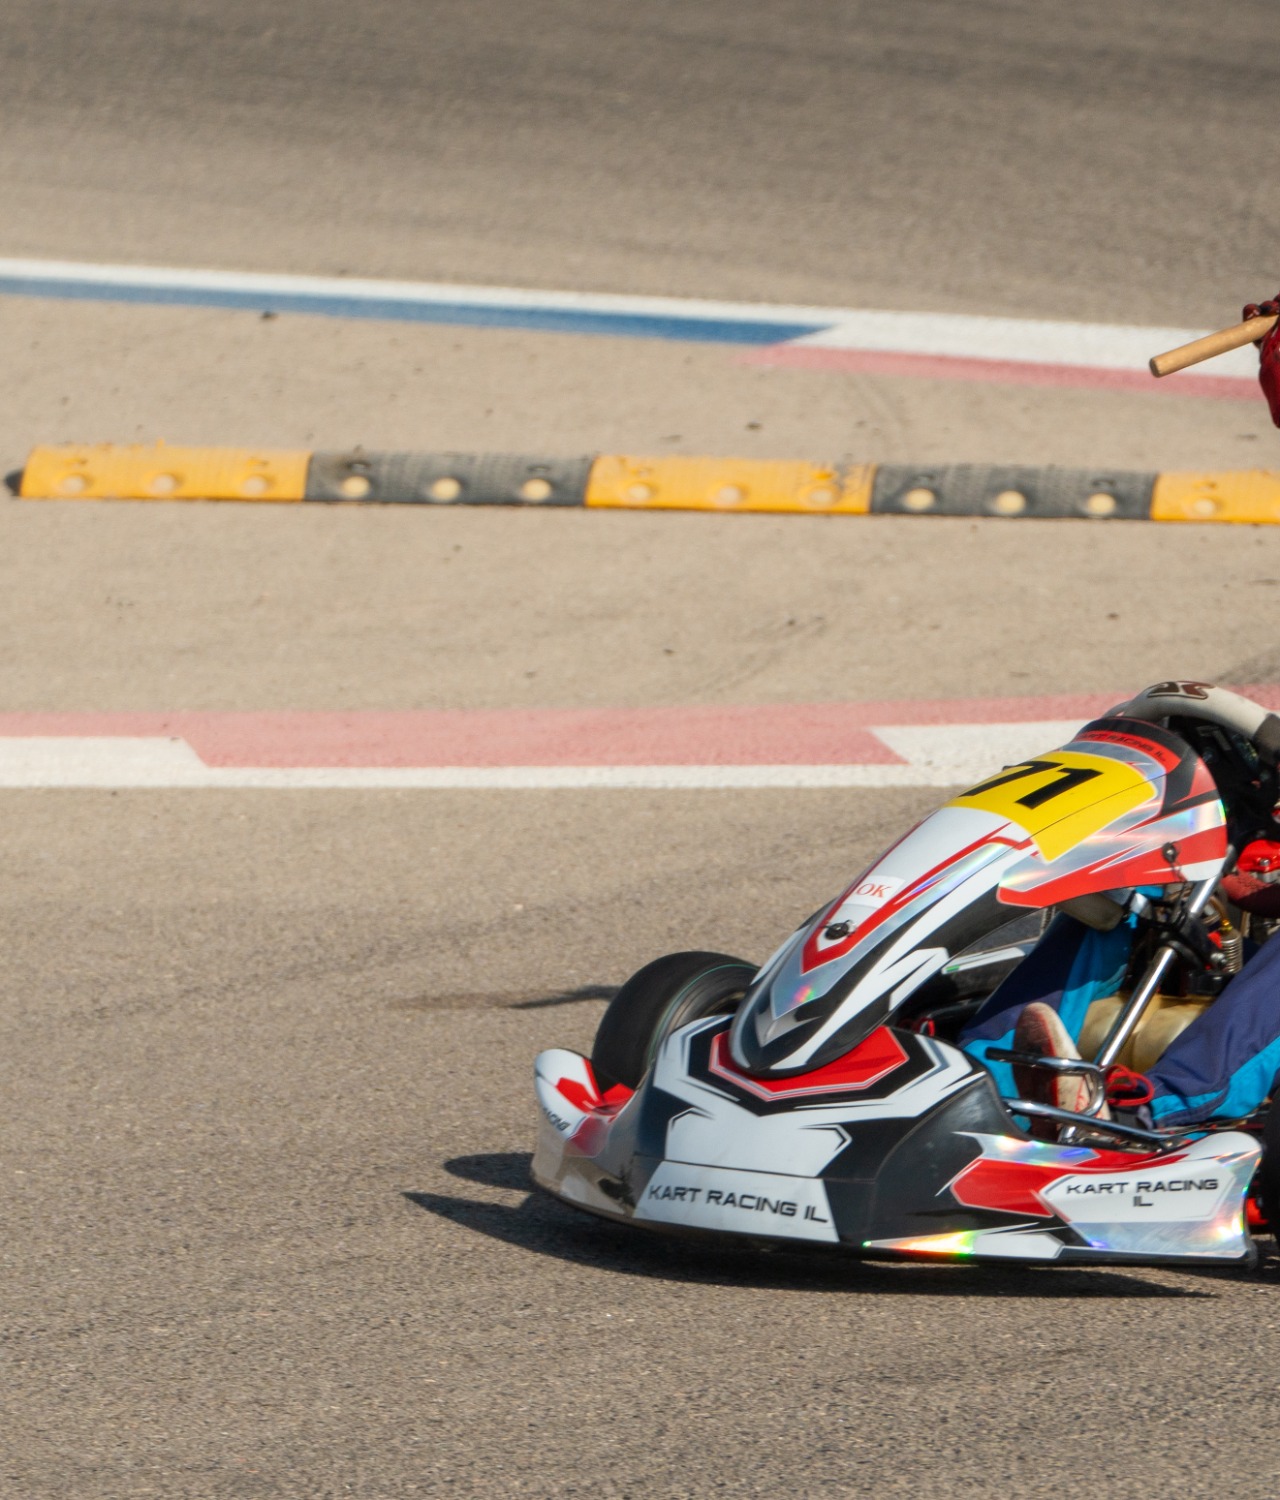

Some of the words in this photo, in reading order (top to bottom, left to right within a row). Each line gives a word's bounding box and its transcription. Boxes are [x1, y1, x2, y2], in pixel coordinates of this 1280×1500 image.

[957, 761, 1104, 810] 71
[856, 882, 892, 899] OK
[1066, 1182, 1129, 1194] KART
[1136, 1179, 1218, 1193] RACING
[649, 1185, 702, 1203] KART
[706, 1190, 797, 1217] RACING
[804, 1205, 828, 1223] IL
[1133, 1196, 1153, 1207] IL
